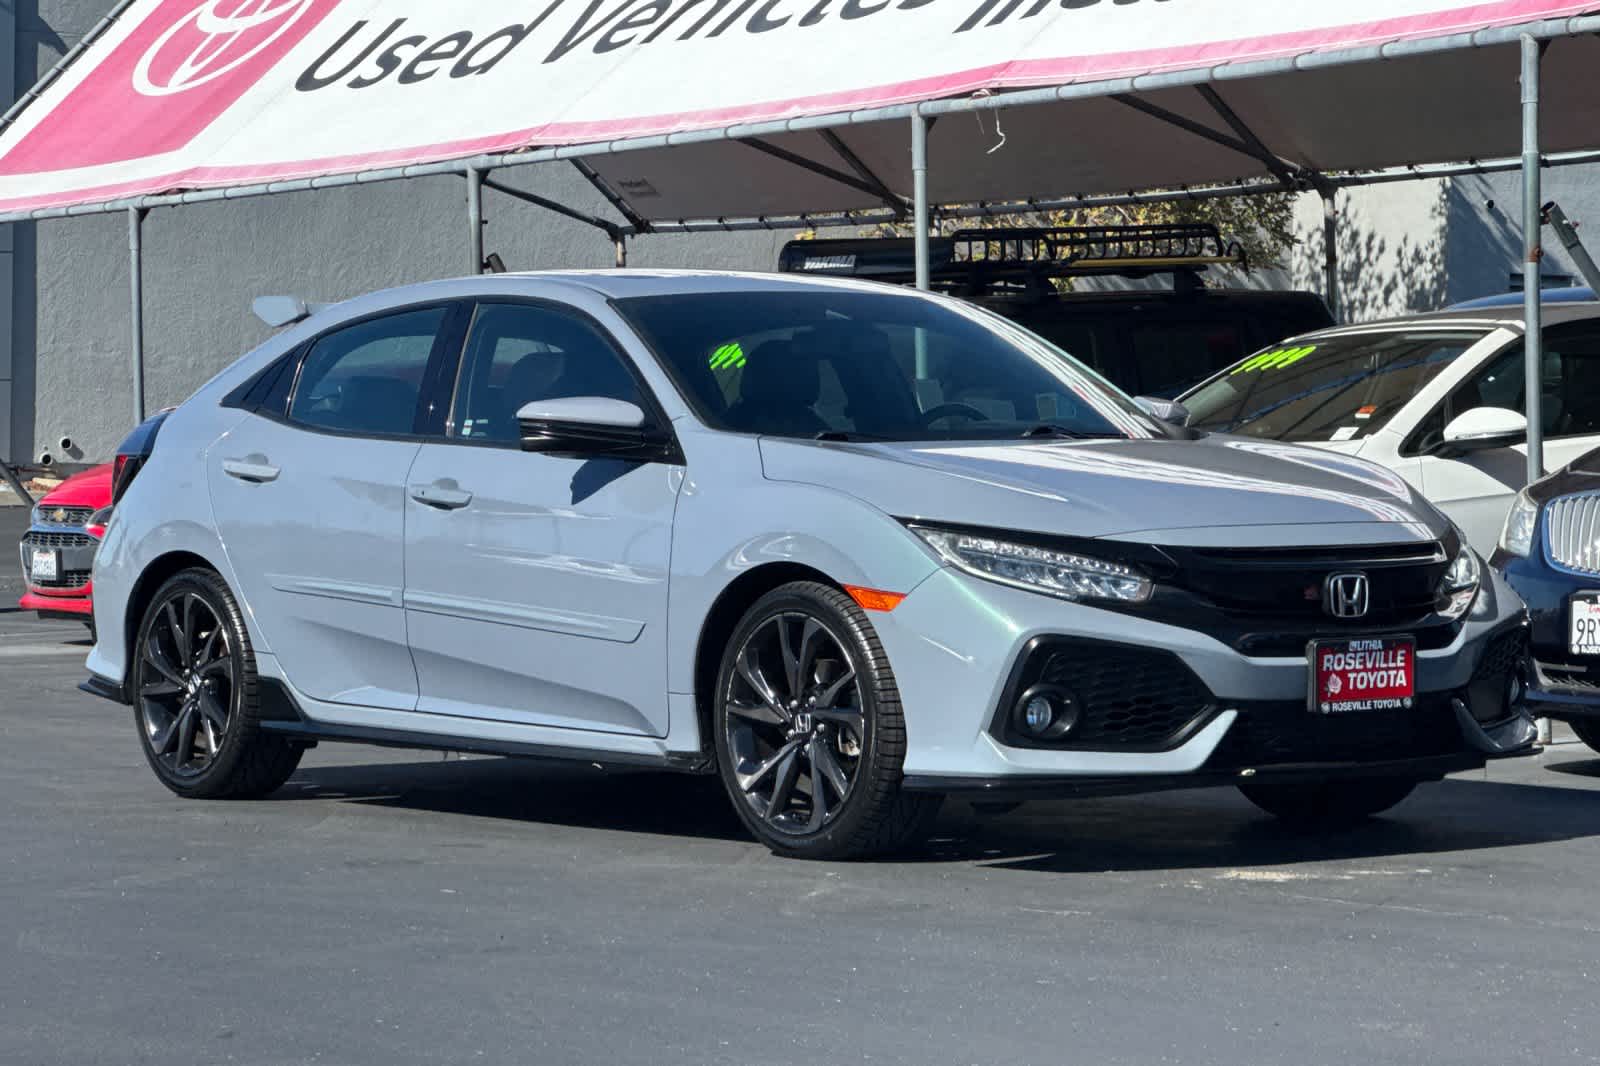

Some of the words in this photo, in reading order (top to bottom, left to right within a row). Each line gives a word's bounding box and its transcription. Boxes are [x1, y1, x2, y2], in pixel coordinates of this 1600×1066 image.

[295, 0, 566, 92] Used
[1323, 650, 1406, 671] ROSEVILLE
[1348, 670, 1407, 690] TOYOTA
[1332, 701, 1372, 712] ROSEVILLE
[1374, 699, 1402, 710] TOYOTA
